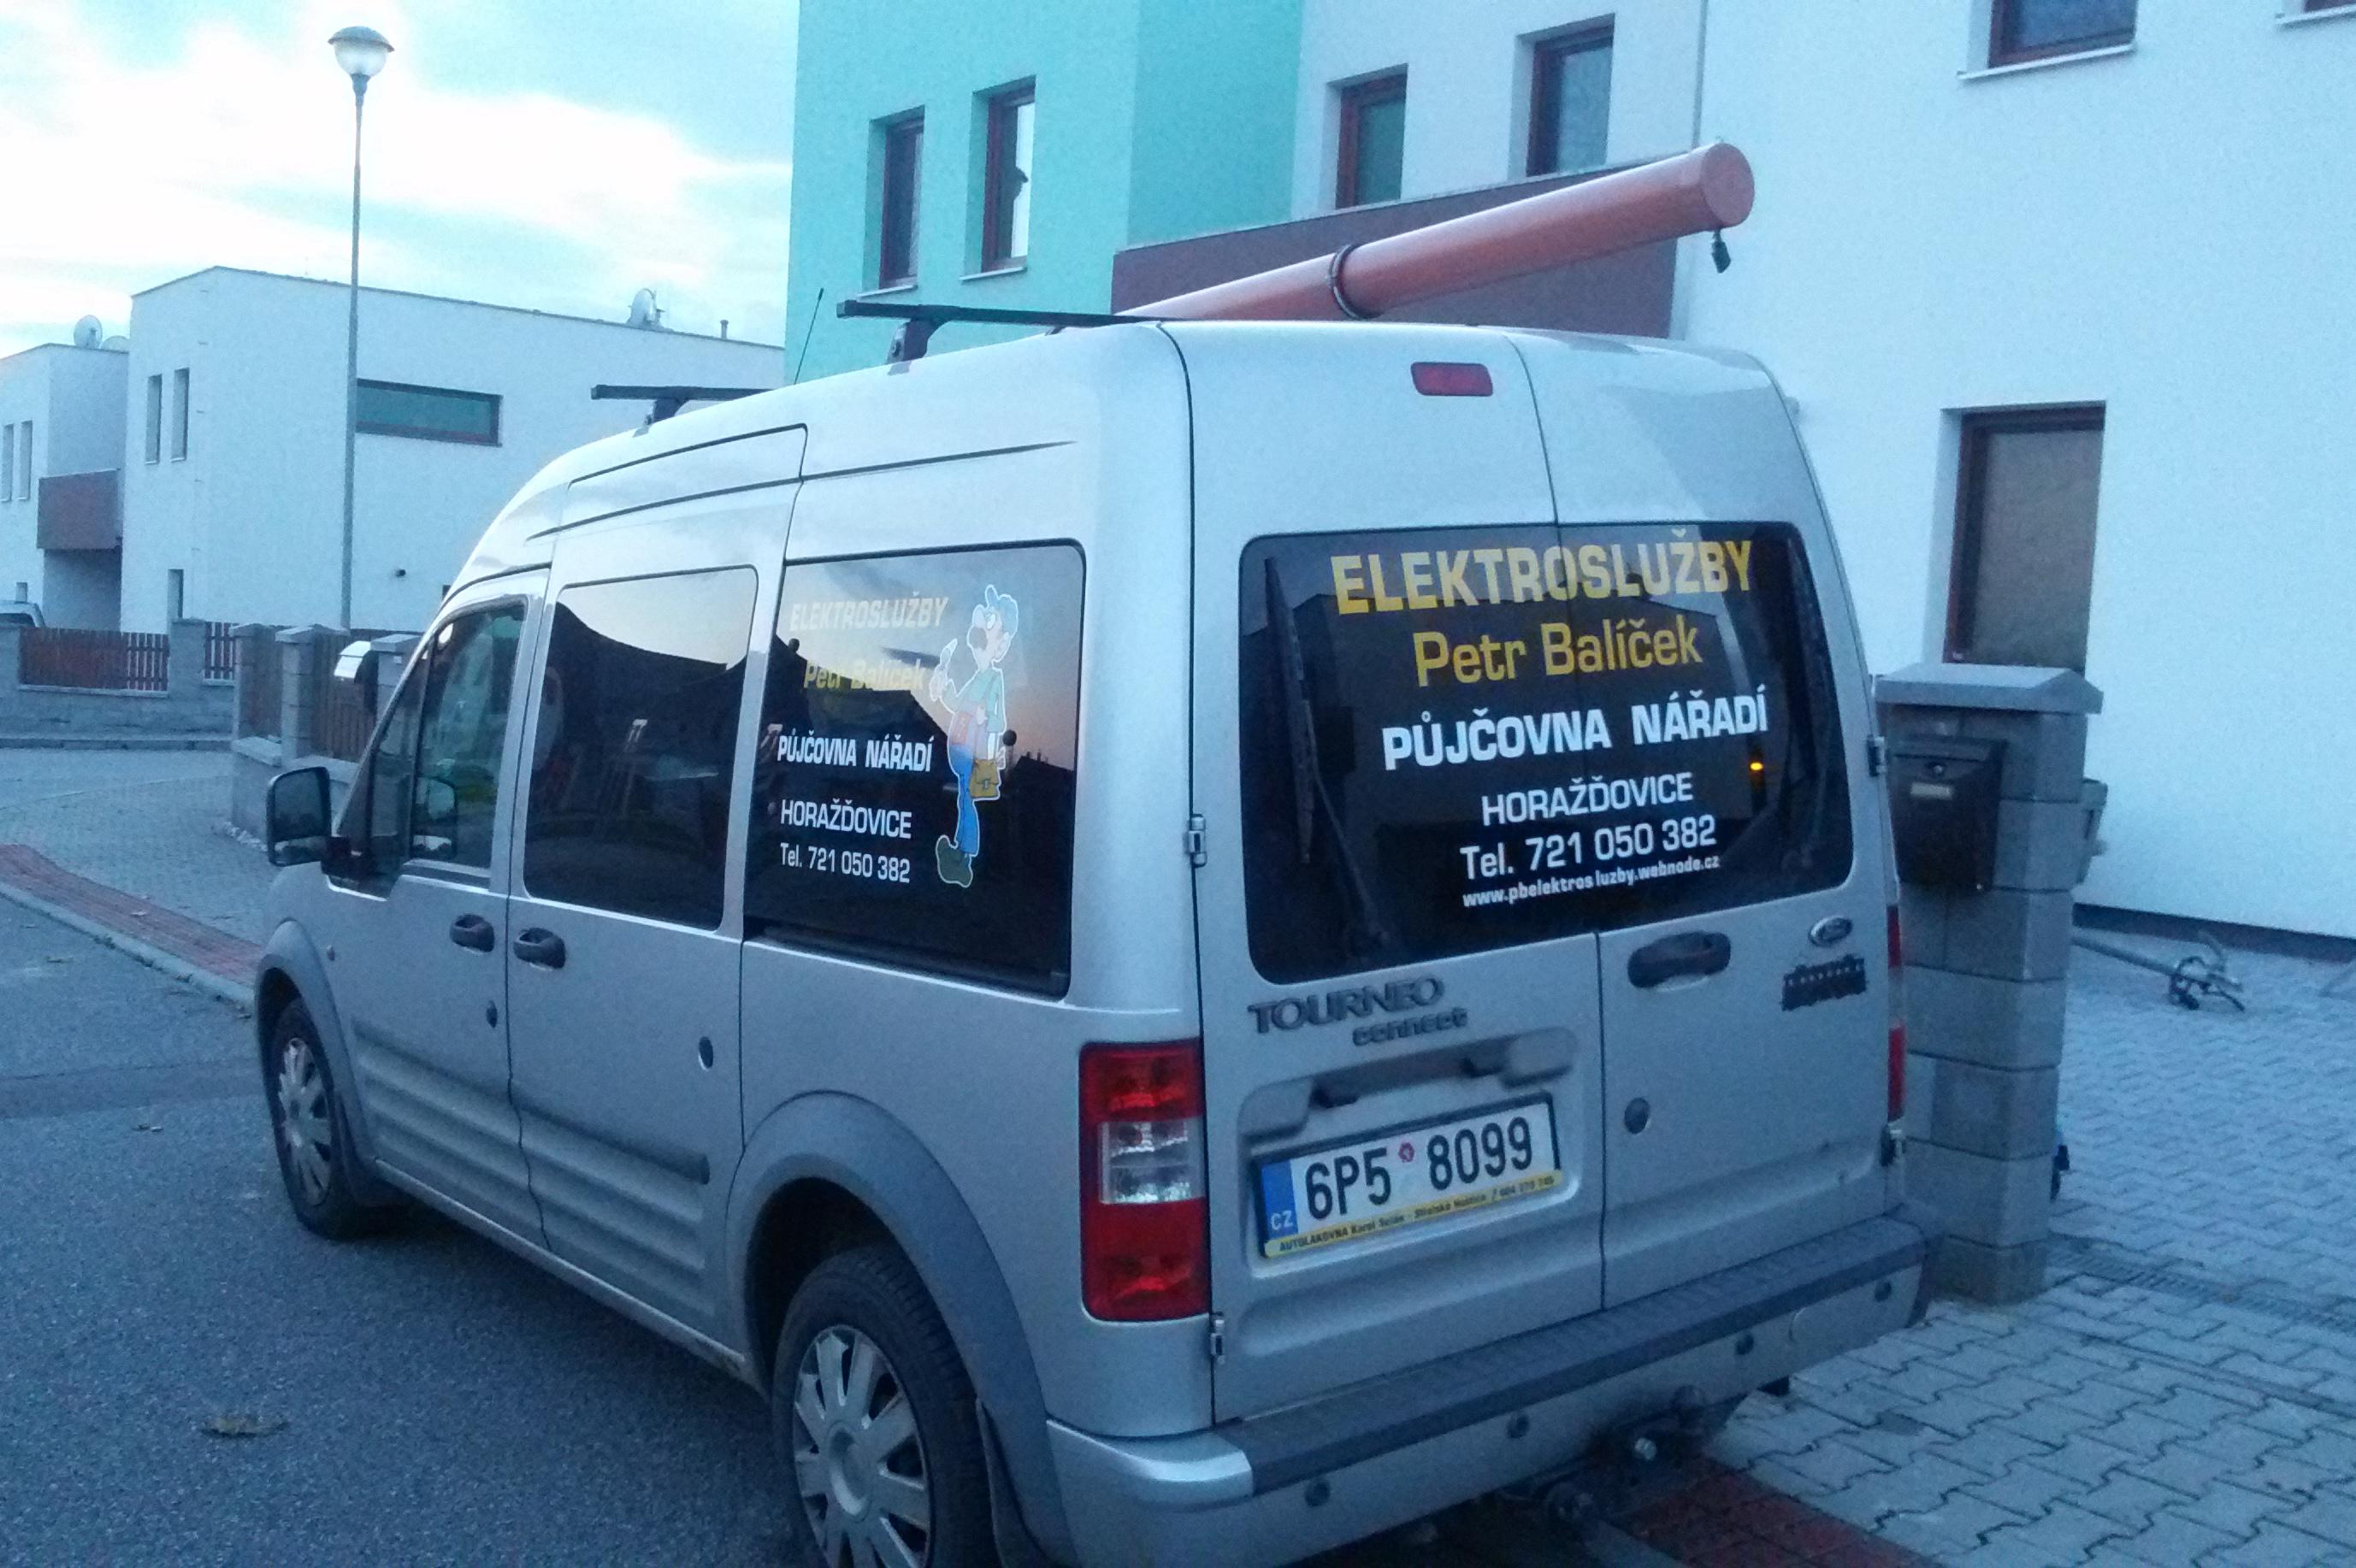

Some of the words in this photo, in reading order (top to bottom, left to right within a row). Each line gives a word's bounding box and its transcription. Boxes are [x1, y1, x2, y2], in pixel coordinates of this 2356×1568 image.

[1330, 528, 1752, 616] ELEKTROSLUŽBY
[788, 591, 949, 631] ELEKTROSLUŽBY
[1413, 631, 1526, 687] Petr
[1540, 614, 1703, 676] Balíček
[777, 728, 857, 767] PŮJČOVNA
[865, 733, 935, 772] NÁŘADÍ
[1382, 708, 1612, 769] PŮJČOVNA
[1631, 685, 1769, 746] NÁŘADÍ
[781, 797, 912, 840] HORAŽĎOVICE
[1481, 772, 1693, 826] HORAŽĎOVICE
[780, 842, 802, 868] Tel.
[808, 846, 836, 873] 721
[841, 851, 873, 878] 050
[877, 855, 911, 884] 382
[1460, 842, 1515, 880] Tel.
[1525, 831, 1582, 871] 721
[1594, 823, 1655, 860] 050
[1662, 815, 1717, 851] 382
[1247, 975, 1445, 1035] TOURNEO
[1352, 1005, 1468, 1047] connect
[1305, 1147, 1392, 1220] 6P5
[1426, 1116, 1533, 1191] 8099
[1271, 1210, 1294, 1231] CZ
[1279, 1227, 1349, 1252] AUTOLAKOVNA
